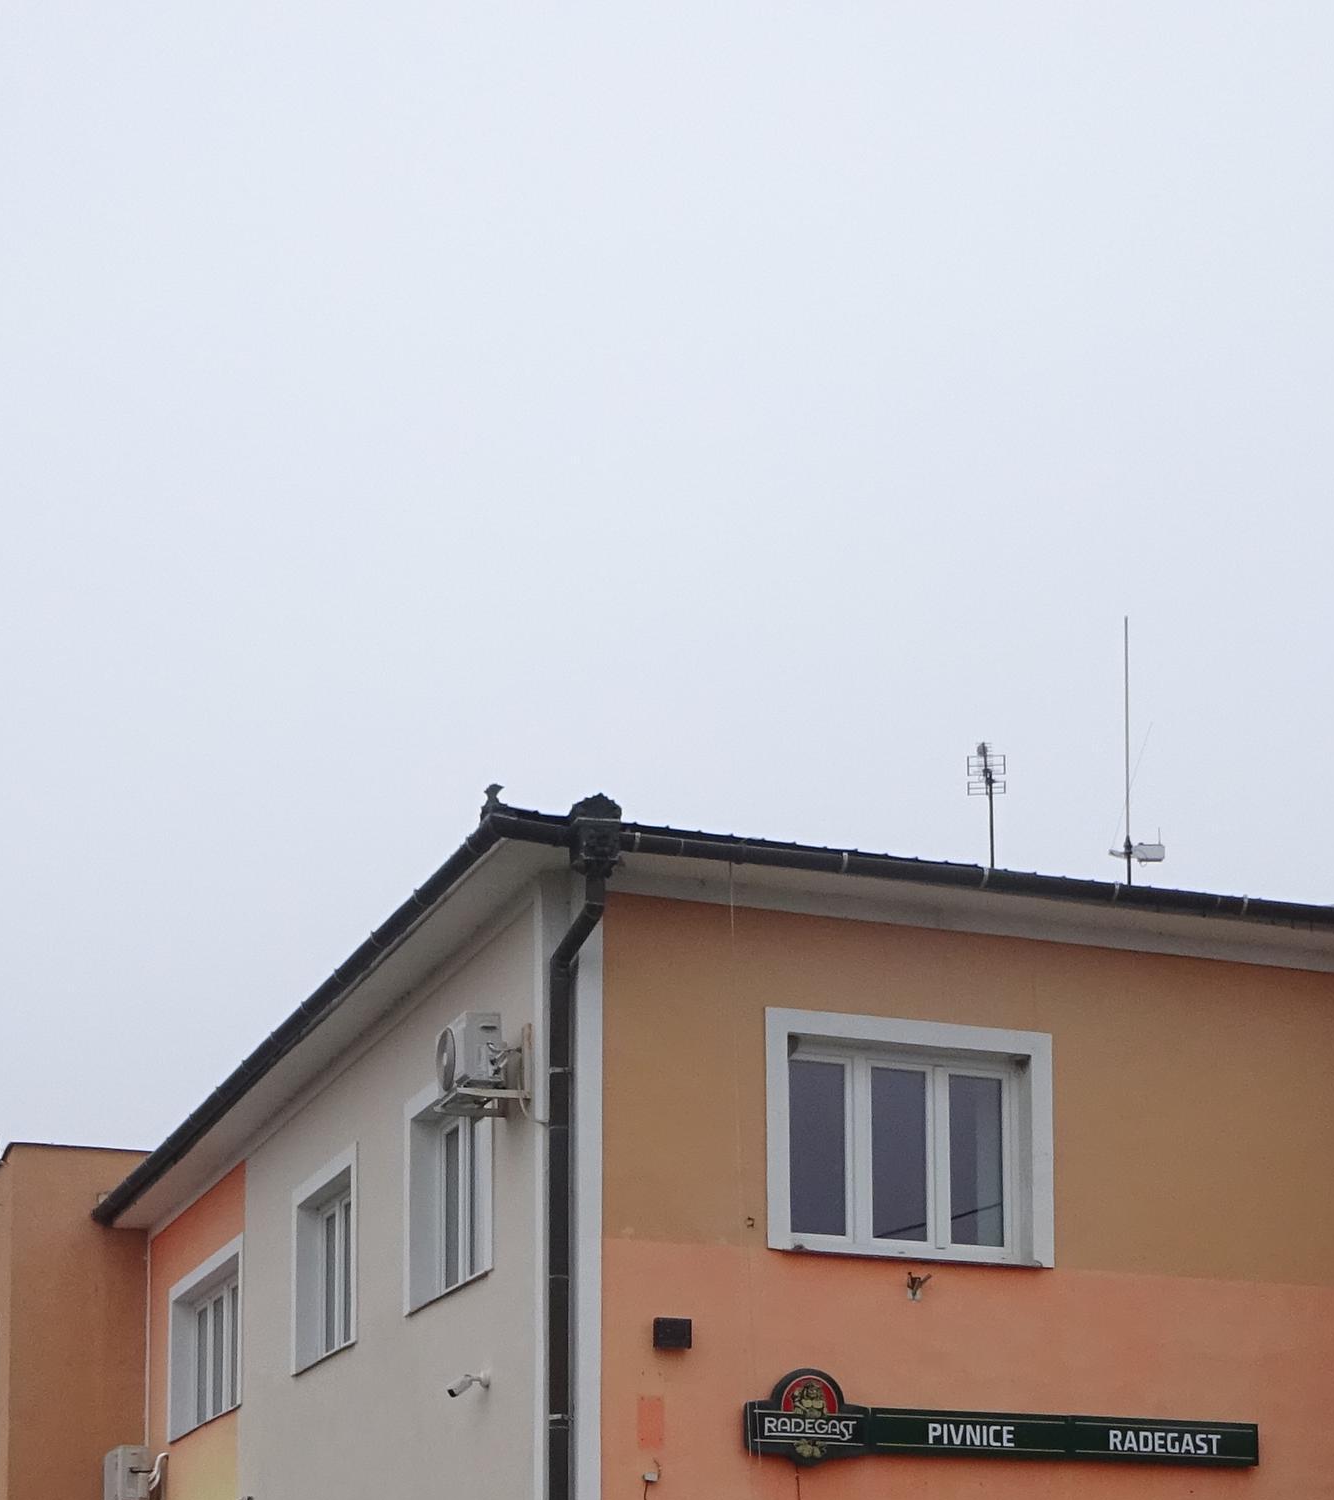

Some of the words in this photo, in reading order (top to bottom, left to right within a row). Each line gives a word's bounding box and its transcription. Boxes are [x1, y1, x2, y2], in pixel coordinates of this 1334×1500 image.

[764, 1417, 857, 1441] RADEGAST
[928, 1422, 1015, 1447] PIVNICE
[1109, 1429, 1222, 1455] RADEGAST
